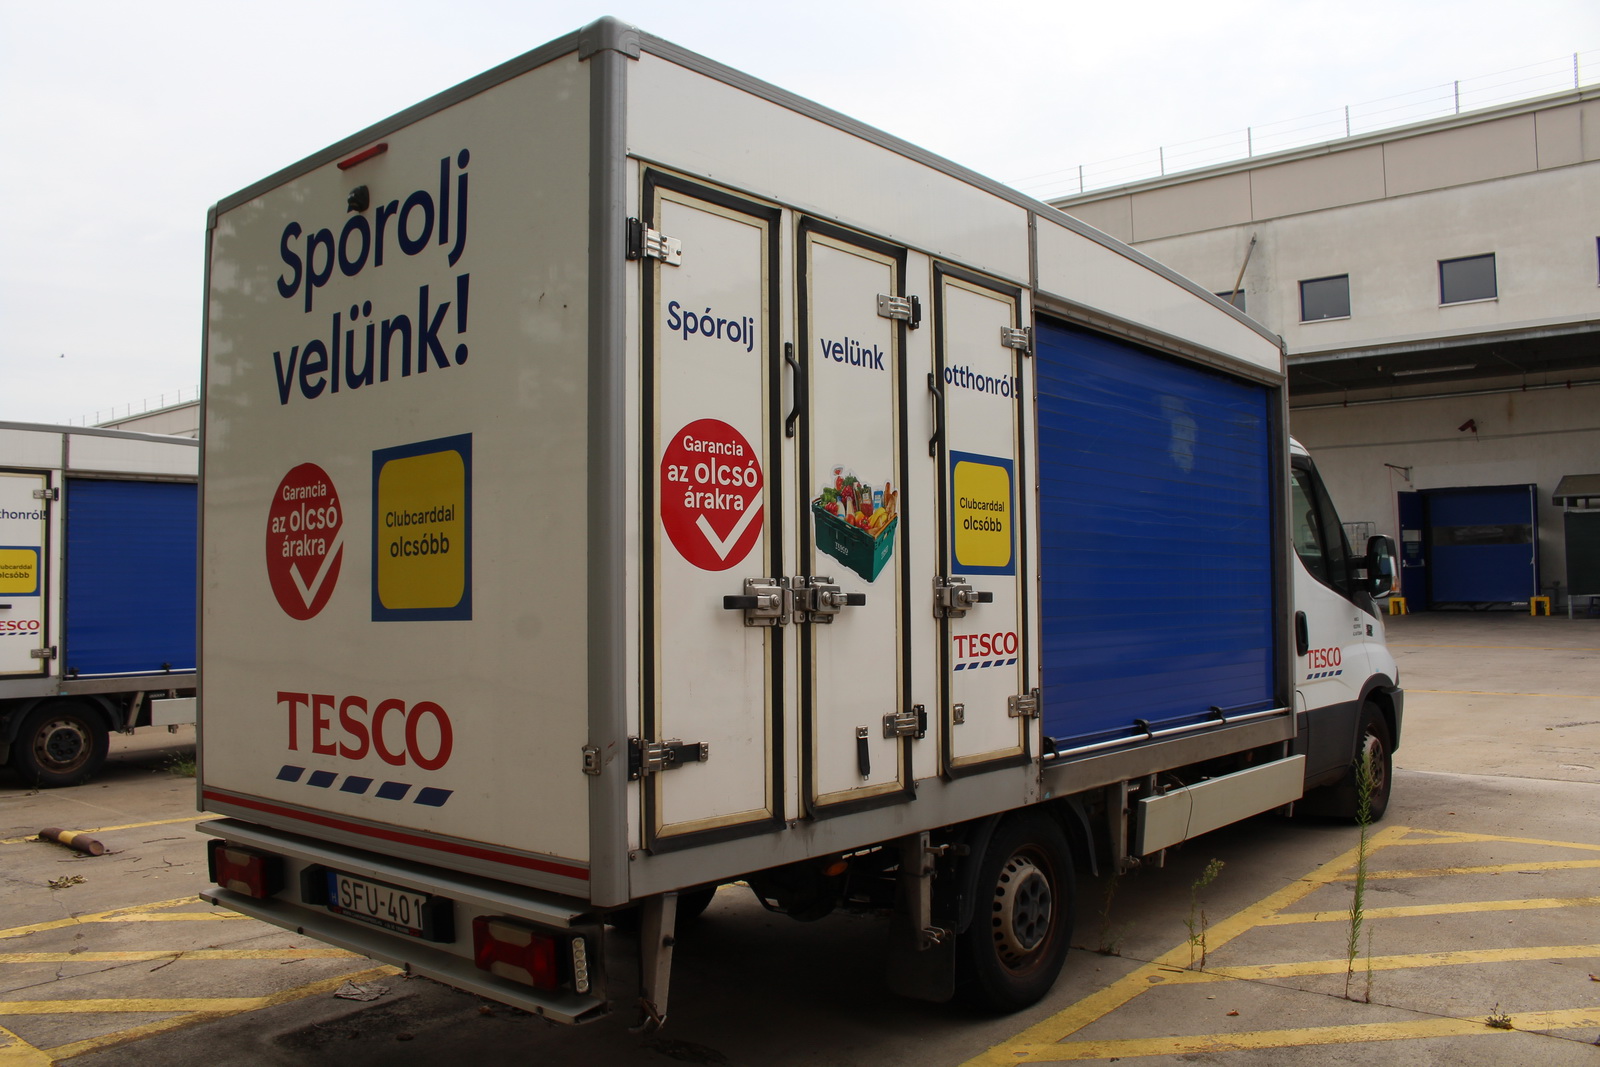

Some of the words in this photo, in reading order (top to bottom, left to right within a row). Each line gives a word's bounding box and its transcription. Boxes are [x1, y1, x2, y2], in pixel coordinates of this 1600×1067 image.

[276, 148, 470, 313] Spórolj
[272, 273, 470, 405] velünk!
[666, 300, 755, 353] Spórolj
[820, 336, 885, 372] velünk
[944, 364, 1020, 399] otthonról!
[683, 434, 744, 457] Garancia
[667, 463, 689, 483] az
[694, 457, 759, 488] olcsó
[282, 480, 328, 502] Garancia
[683, 485, 744, 512] árakra
[959, 496, 1006, 513] Clubcarddal
[271, 514, 287, 534] az
[289, 498, 339, 531] olcsó
[385, 503, 456, 529] Clubcarddal
[963, 513, 1003, 533] olcsóbb
[281, 535, 327, 559] árakra
[389, 532, 451, 559] olcsóbb
[953, 631, 1019, 659] TESCO
[1307, 647, 1341, 669] TESCO
[276, 691, 453, 771] TESCO
[341, 879, 422, 928] SFU-401
